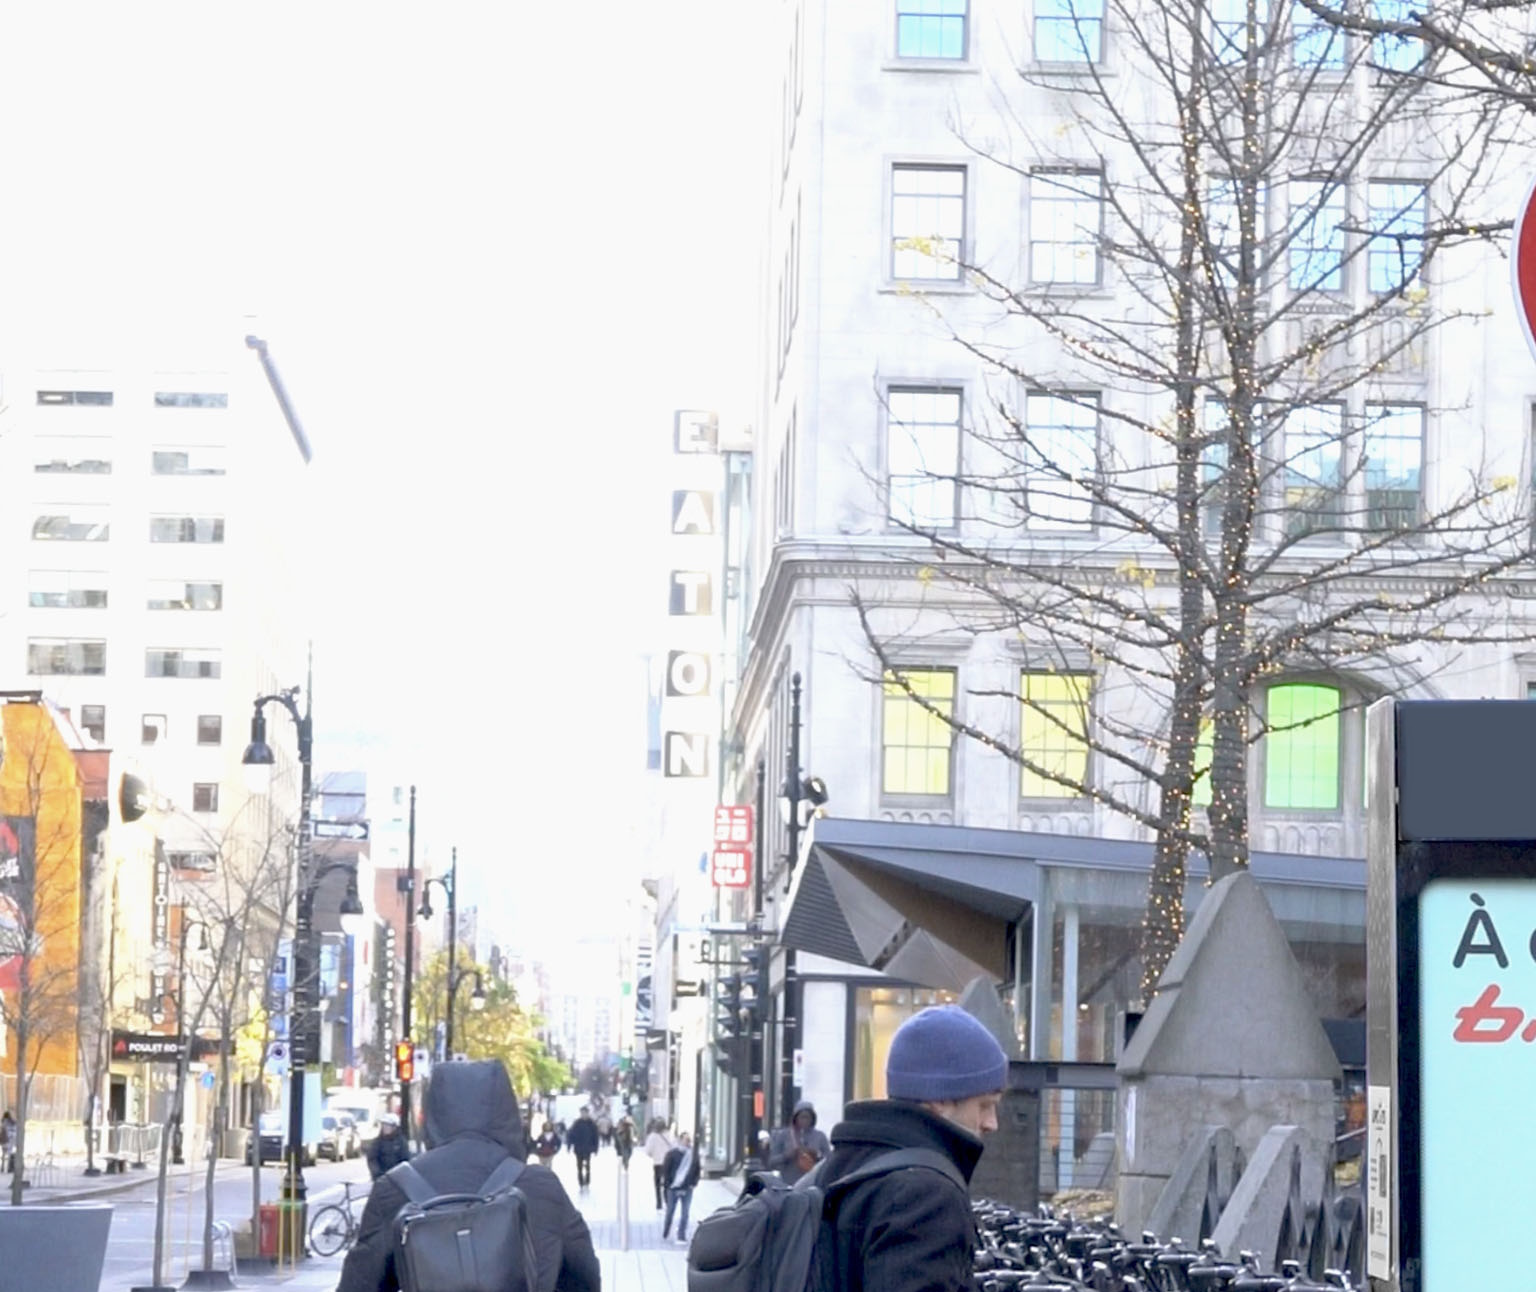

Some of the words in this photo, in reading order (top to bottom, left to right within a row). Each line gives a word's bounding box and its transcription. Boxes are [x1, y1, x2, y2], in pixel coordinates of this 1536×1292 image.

[666, 410, 716, 777] EATON
[1453, 893, 1510, 971] À
[129, 1043, 164, 1053] POULET
